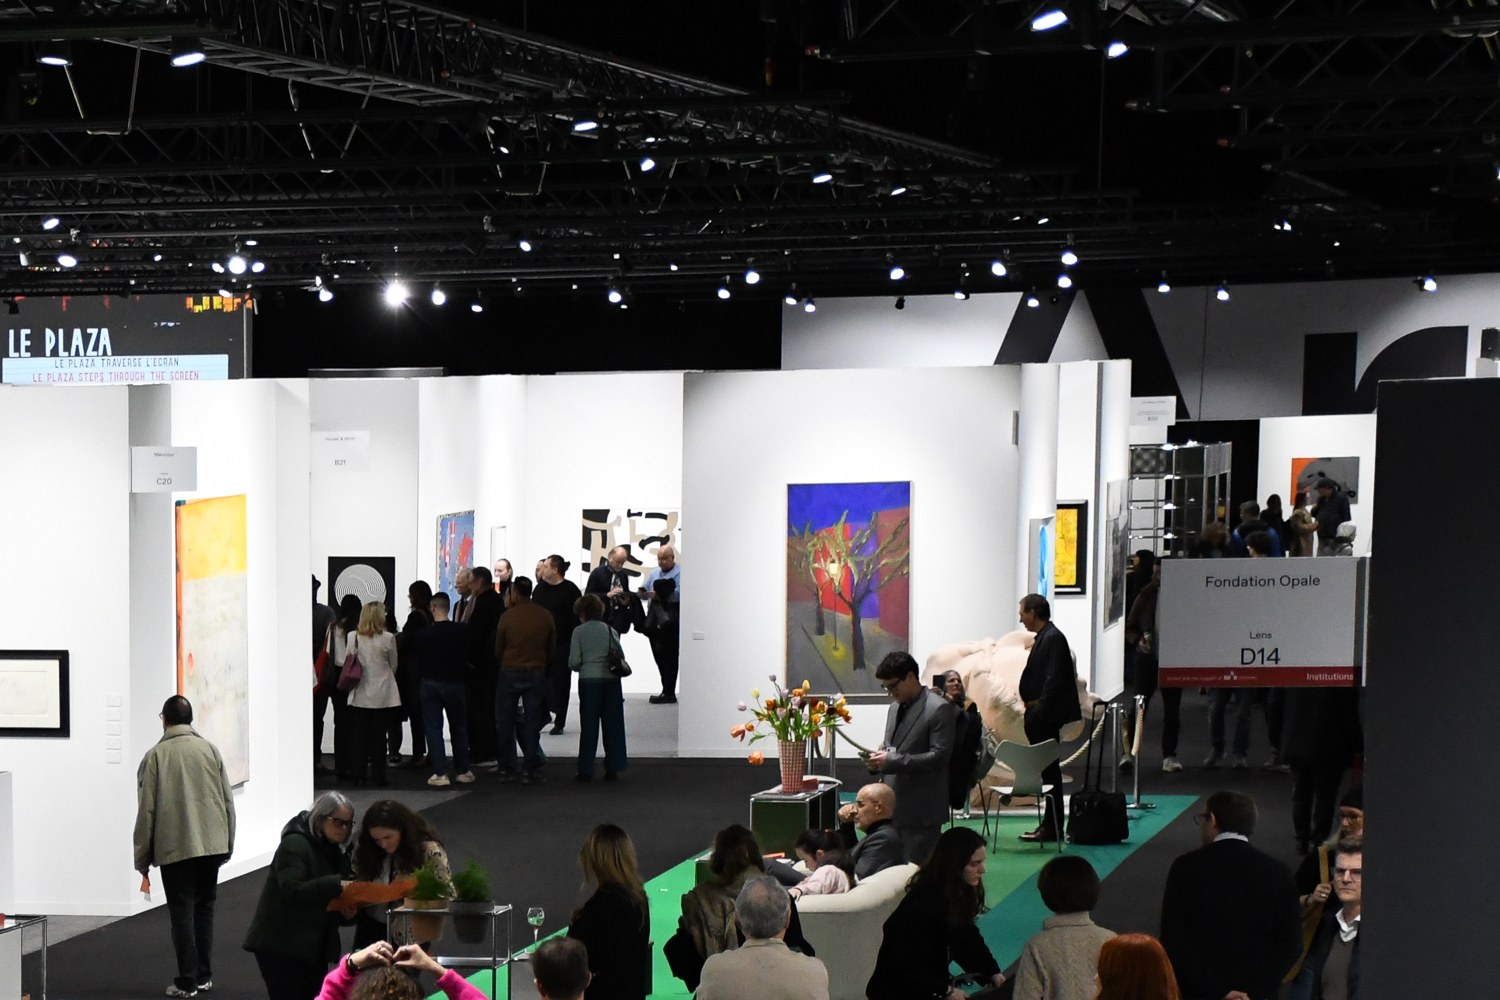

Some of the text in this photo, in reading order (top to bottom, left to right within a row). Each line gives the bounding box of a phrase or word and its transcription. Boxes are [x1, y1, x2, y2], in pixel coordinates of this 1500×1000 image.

[8, 327, 112, 358] LE PLAZA
[54, 359, 64, 368] LE
[68, 358, 96, 368] PLAZA
[101, 358, 142, 368] TRAVERSE
[32, 371, 200, 383] LE PLAZA STEPS THROUGH THE SCREEN
[156, 477, 173, 486] C20
[1205, 574, 1321, 589] Fondation Opale
[1249, 631, 1273, 640] Lens
[1240, 647, 1281, 665] D14
[1306, 672, 1354, 682] Institutions
